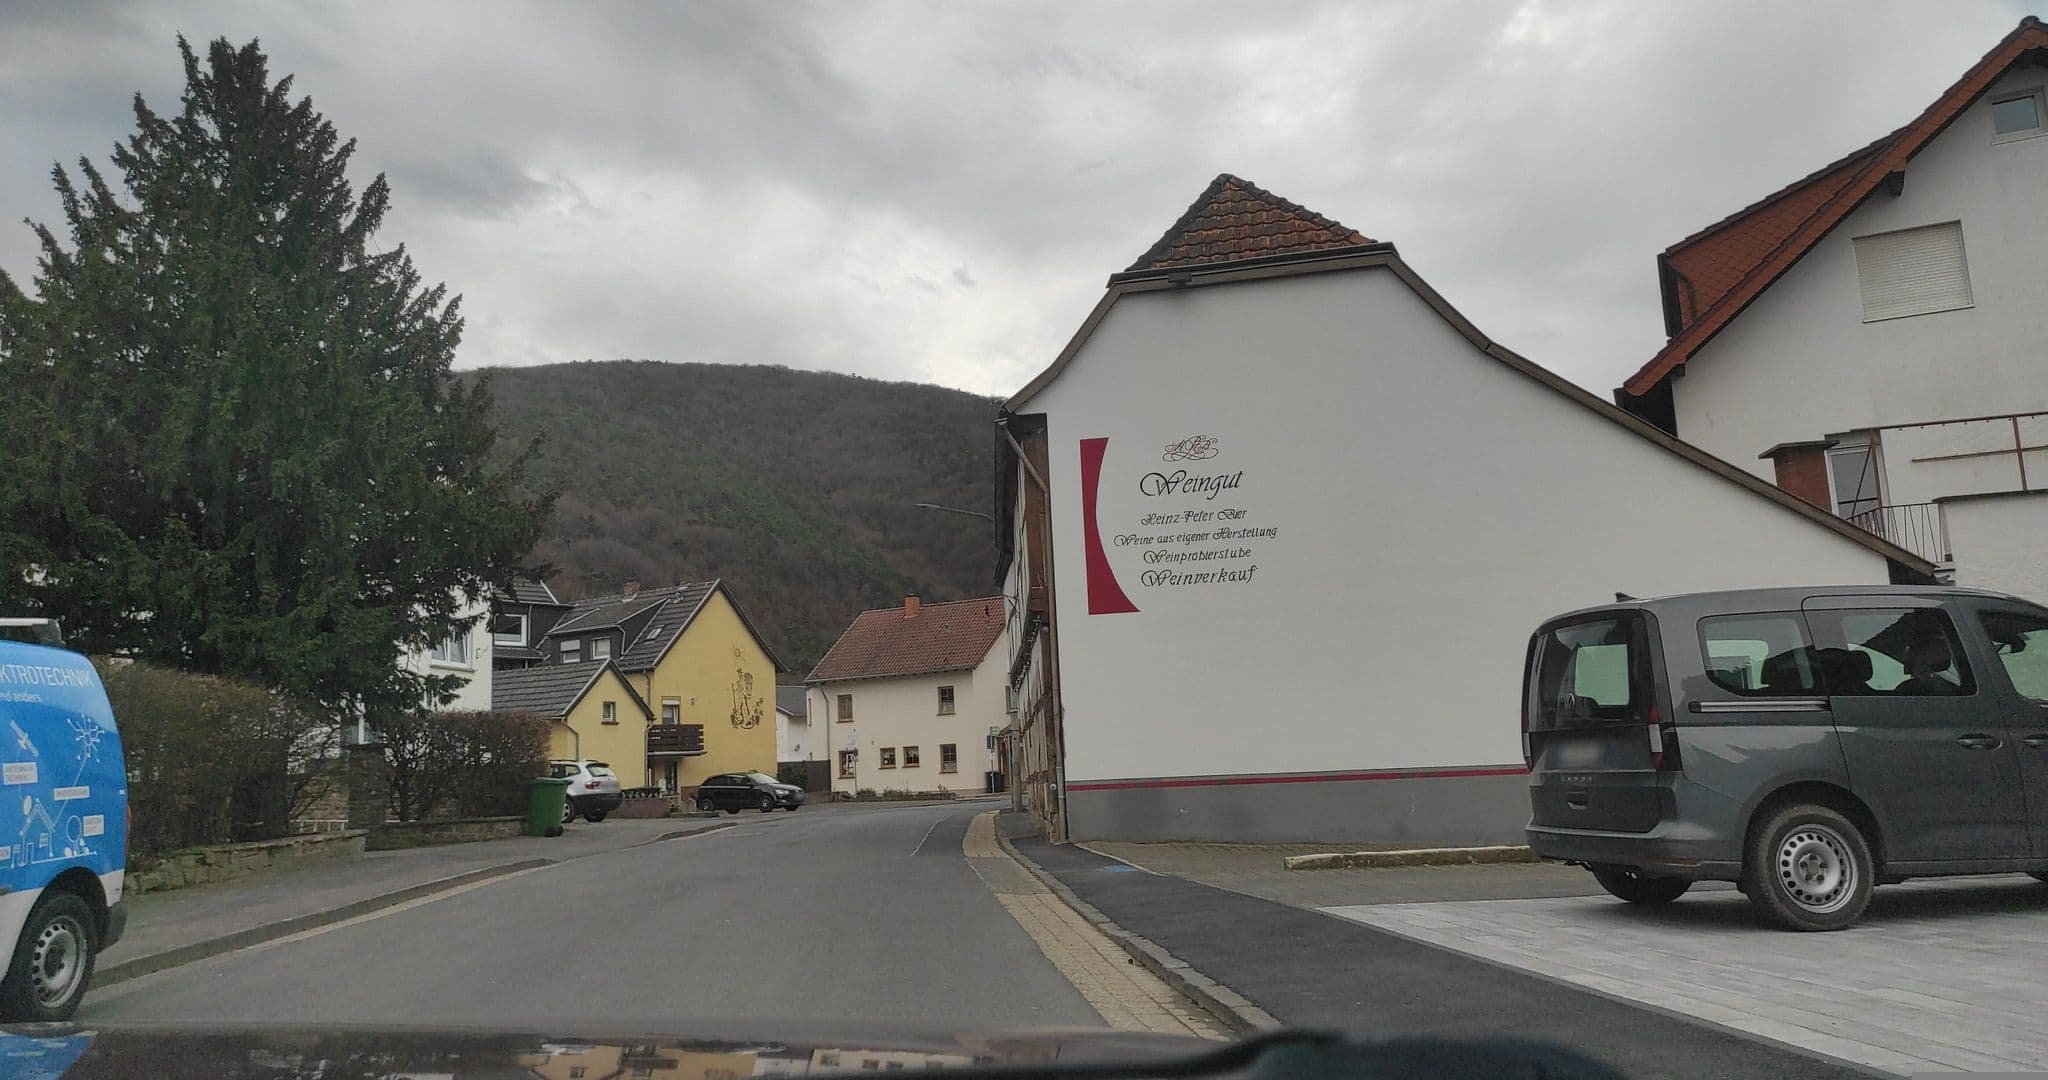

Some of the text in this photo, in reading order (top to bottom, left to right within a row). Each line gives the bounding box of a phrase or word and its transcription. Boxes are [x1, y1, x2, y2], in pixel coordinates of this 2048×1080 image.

[1140, 469, 1243, 500] Weingut
[1141, 508, 1248, 526] Heinz-Peter Bier
[1114, 526, 1278, 546] Weine aus eigener Herstellung
[1143, 547, 1251, 565] Weinprobierstube
[1141, 564, 1258, 587] Weinverkauf
